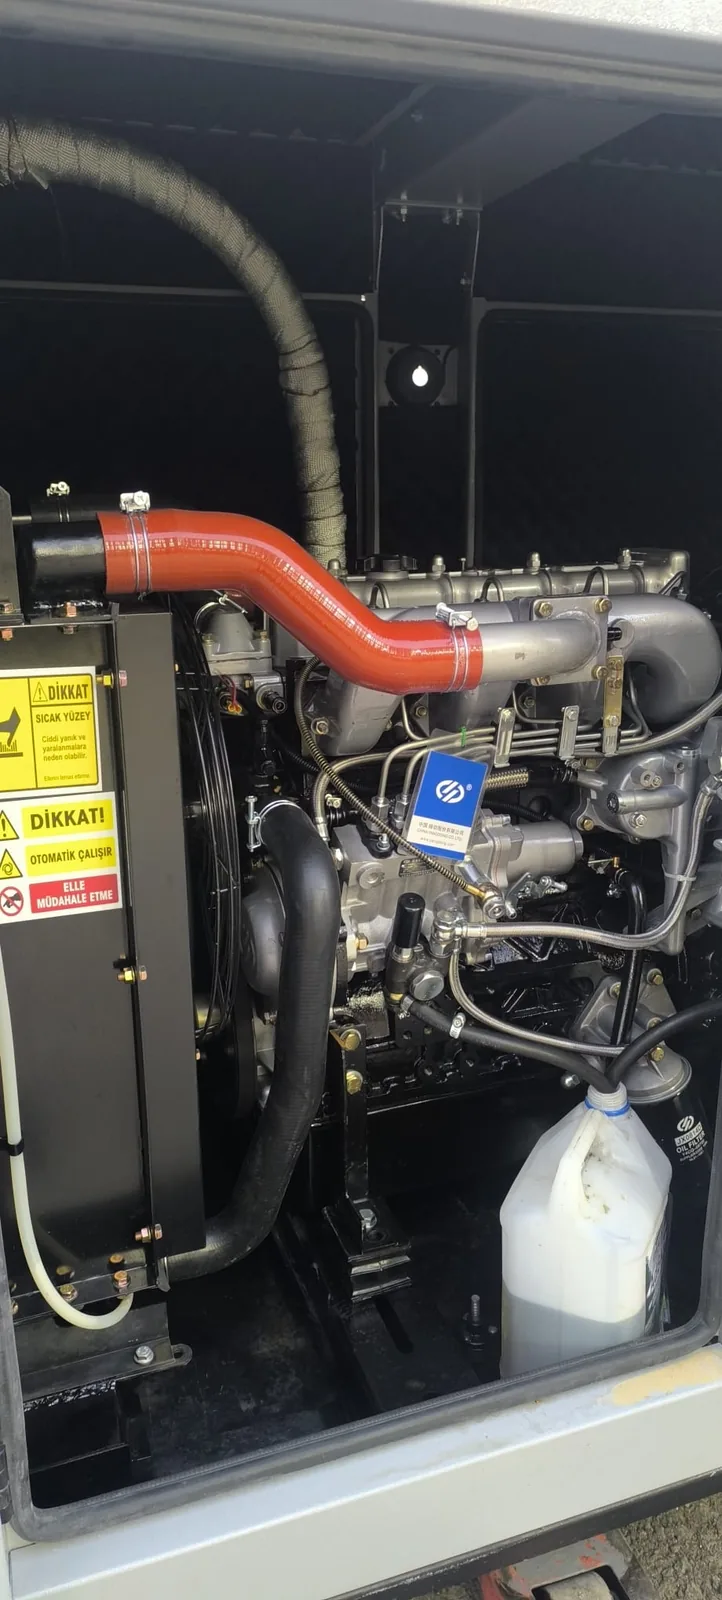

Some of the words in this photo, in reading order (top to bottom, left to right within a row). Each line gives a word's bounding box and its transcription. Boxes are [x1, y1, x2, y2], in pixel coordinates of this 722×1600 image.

[48, 681, 88, 700] DİKKAT
[36, 713, 61, 723] SICAK
[63, 710, 91, 721] YÜZEY
[42, 735, 59, 743] Ciddi
[42, 743, 87, 753] yaralanmalara
[43, 754, 63, 762] neden
[30, 807, 105, 830] DİKKAT!
[30, 849, 76, 865] OTOMATİK
[78, 847, 113, 862] ÇALIŞIR
[63, 880, 86, 893] ELLE
[37, 893, 87, 909] MÜDAHALE
[89, 890, 114, 902] ETME
[676, 1145, 689, 1154] OIL
[687, 1130, 705, 1149] FILTER
